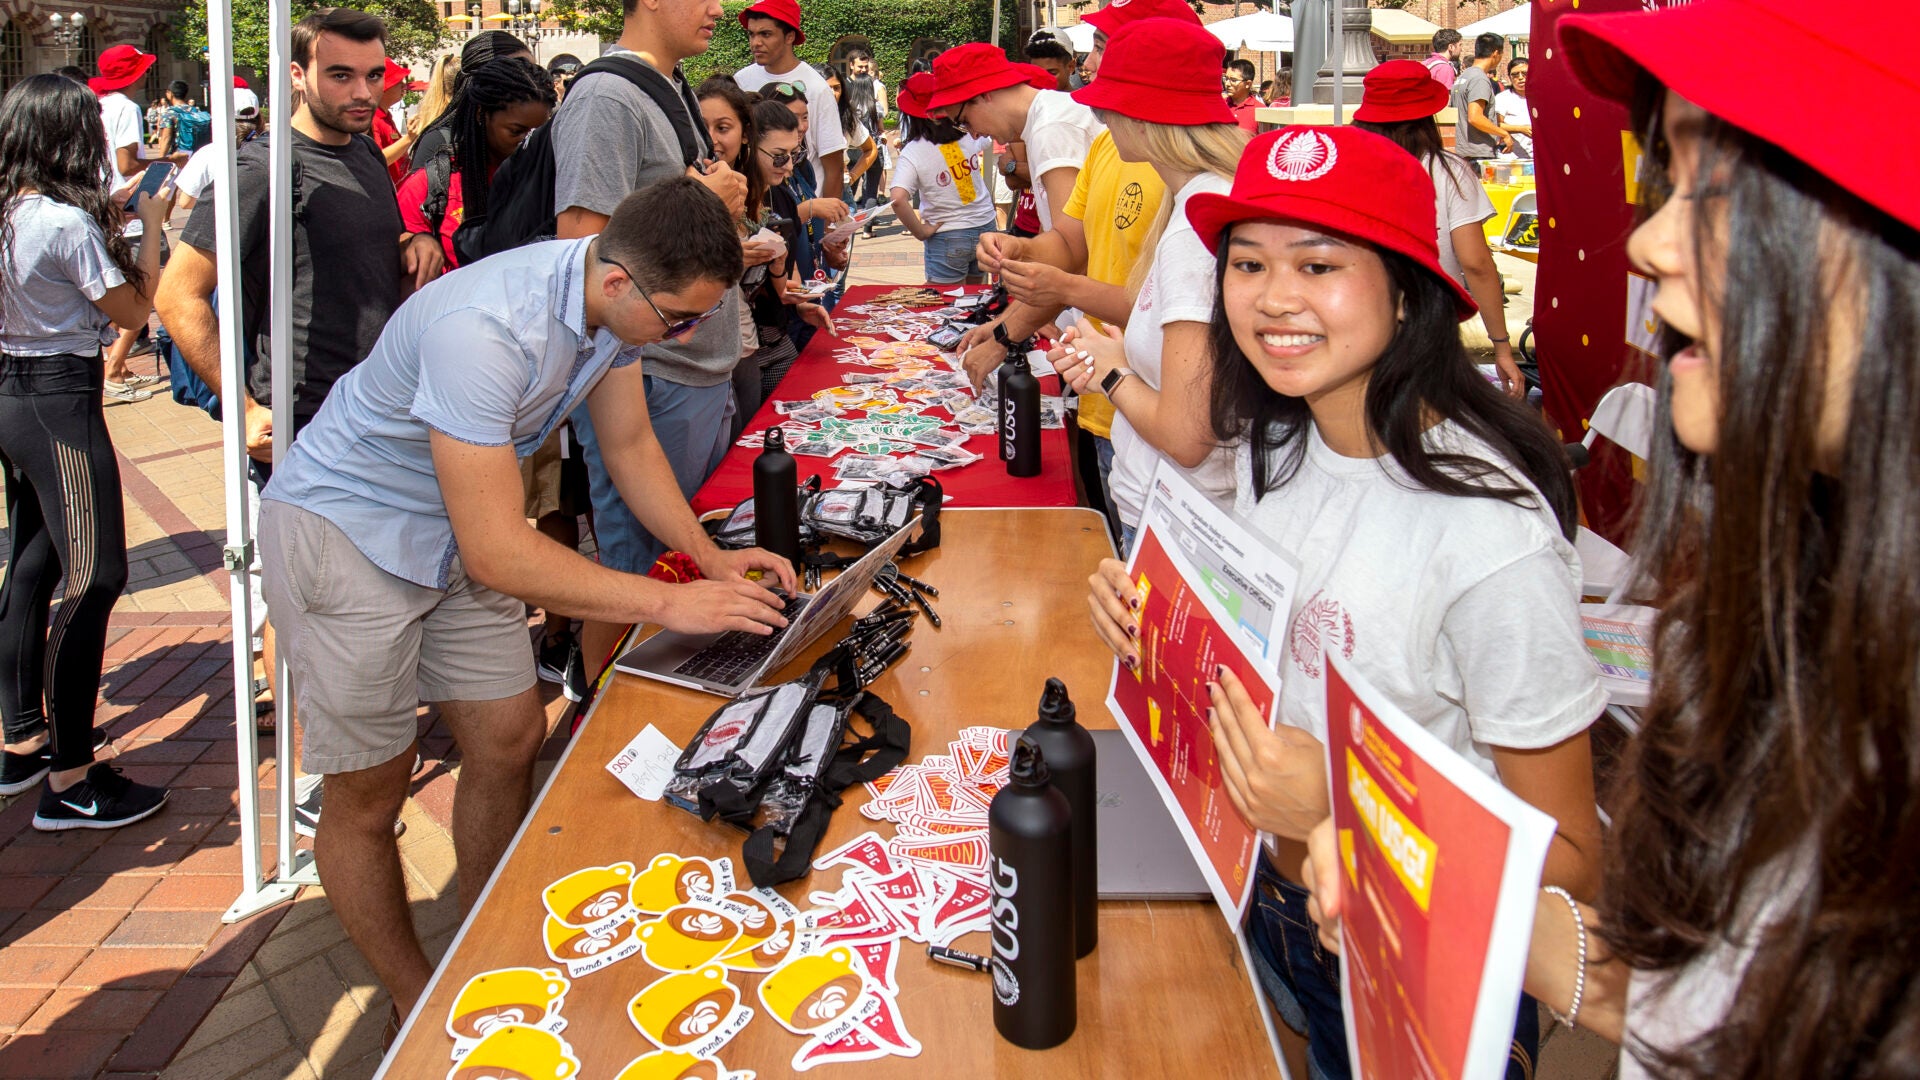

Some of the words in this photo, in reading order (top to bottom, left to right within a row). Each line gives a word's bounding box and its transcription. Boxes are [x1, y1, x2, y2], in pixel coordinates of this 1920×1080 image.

[1005, 398, 1016, 441] USG
[1222, 564, 1248, 591] Executive
[1248, 587, 1272, 612] Officers
[611, 754, 633, 774] USG
[1351, 765, 1377, 829] Join
[1378, 803, 1428, 890] USG!
[862, 844, 880, 866] USC
[879, 884, 913, 896] USC
[952, 889, 985, 907] USC
[695, 893, 713, 903] rise
[723, 902, 749, 916] grind
[775, 902, 797, 918] grind
[990, 852, 1019, 961] USG
[592, 919, 619, 936] grind
[830, 913, 866, 924] USC
[617, 944, 637, 957] rise
[868, 945, 883, 963] SC
[573, 959, 603, 976] grind
[860, 999, 876, 1015] rise
[733, 1009, 750, 1028] rise
[824, 1021, 851, 1042] grind
[696, 1035, 724, 1057] grind
